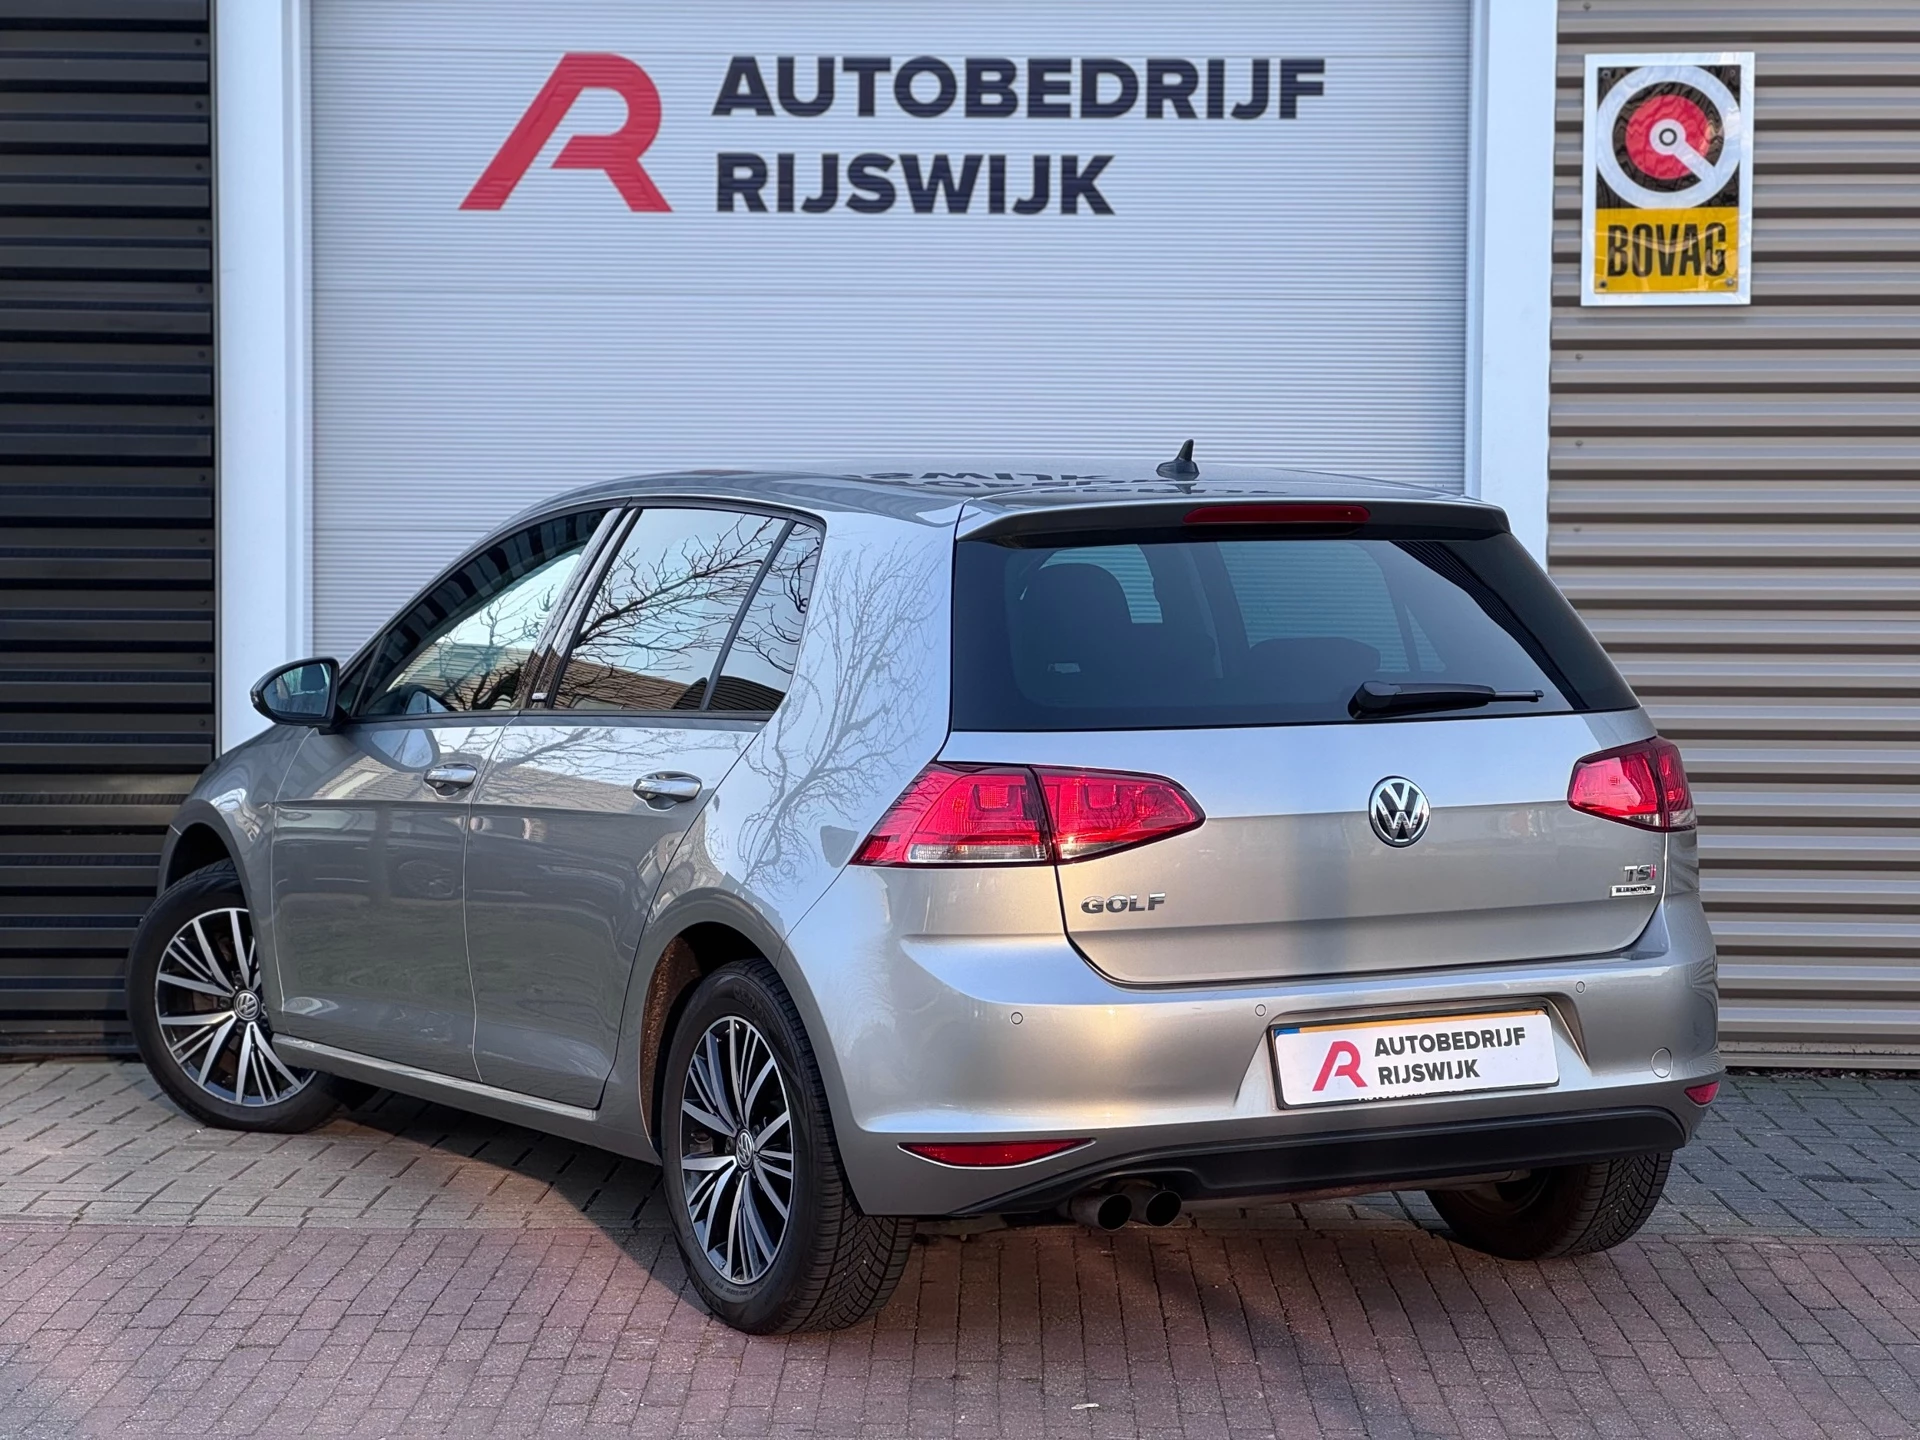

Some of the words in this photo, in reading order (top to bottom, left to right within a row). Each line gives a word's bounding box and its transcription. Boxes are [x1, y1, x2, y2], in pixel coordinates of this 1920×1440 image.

[712, 56, 1325, 119] AUTOBEDRIJF
[717, 153, 1114, 215] RIJSWIJK
[1607, 222, 1727, 278] BOVAG
[1081, 892, 1166, 914] GOLF
[1374, 1027, 1526, 1057] AUTOBEDRIJF
[1378, 1059, 1480, 1085] RIJSWIJK
